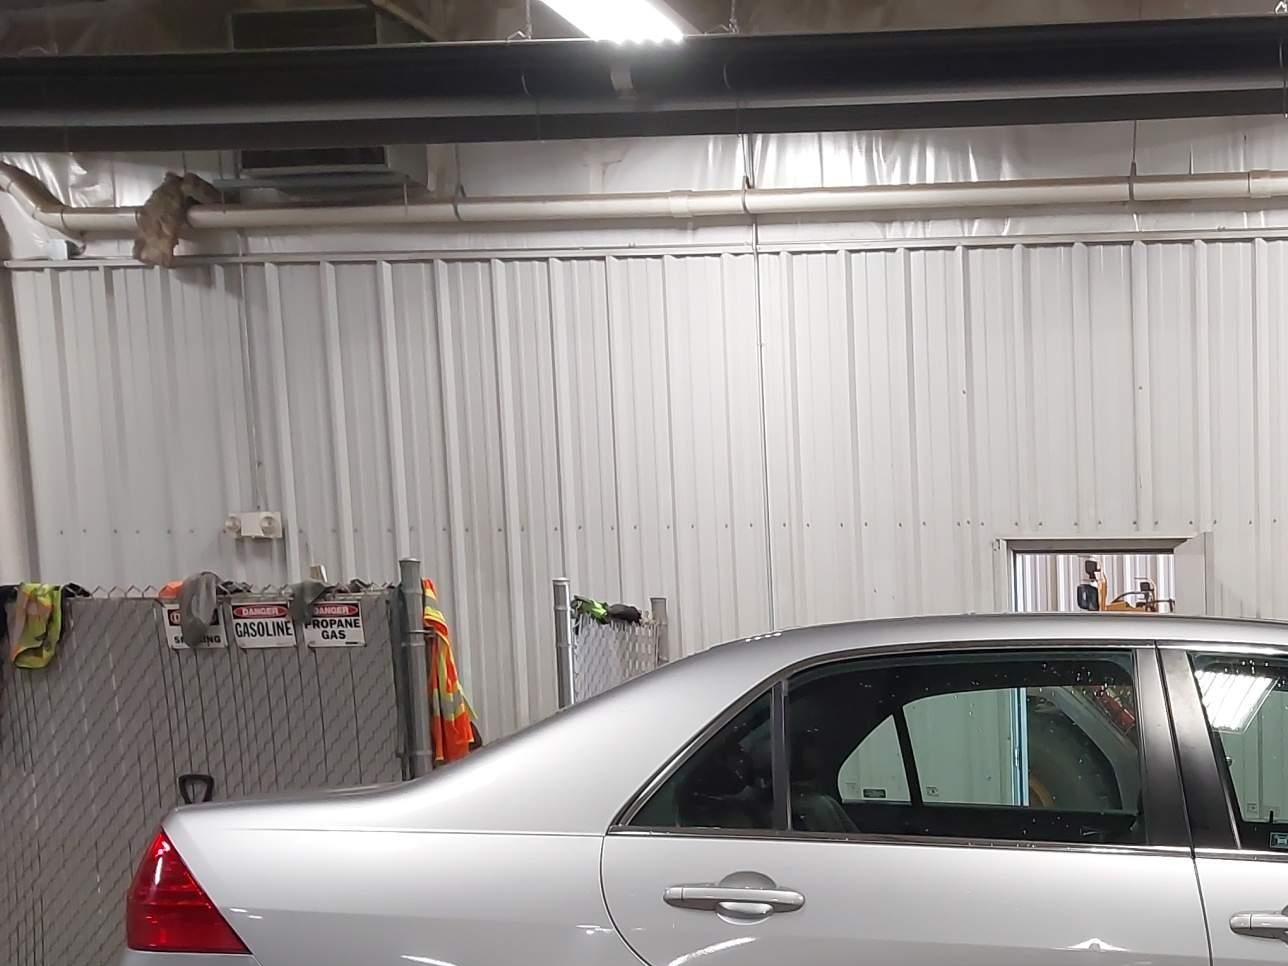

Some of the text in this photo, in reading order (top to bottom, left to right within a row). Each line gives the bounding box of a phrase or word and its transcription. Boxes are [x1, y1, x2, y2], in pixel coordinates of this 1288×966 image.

[242, 607, 280, 616] DANGER
[235, 620, 292, 638] GASOLINE
[174, 634, 222, 644] SING
[321, 630, 346, 640] GAS
